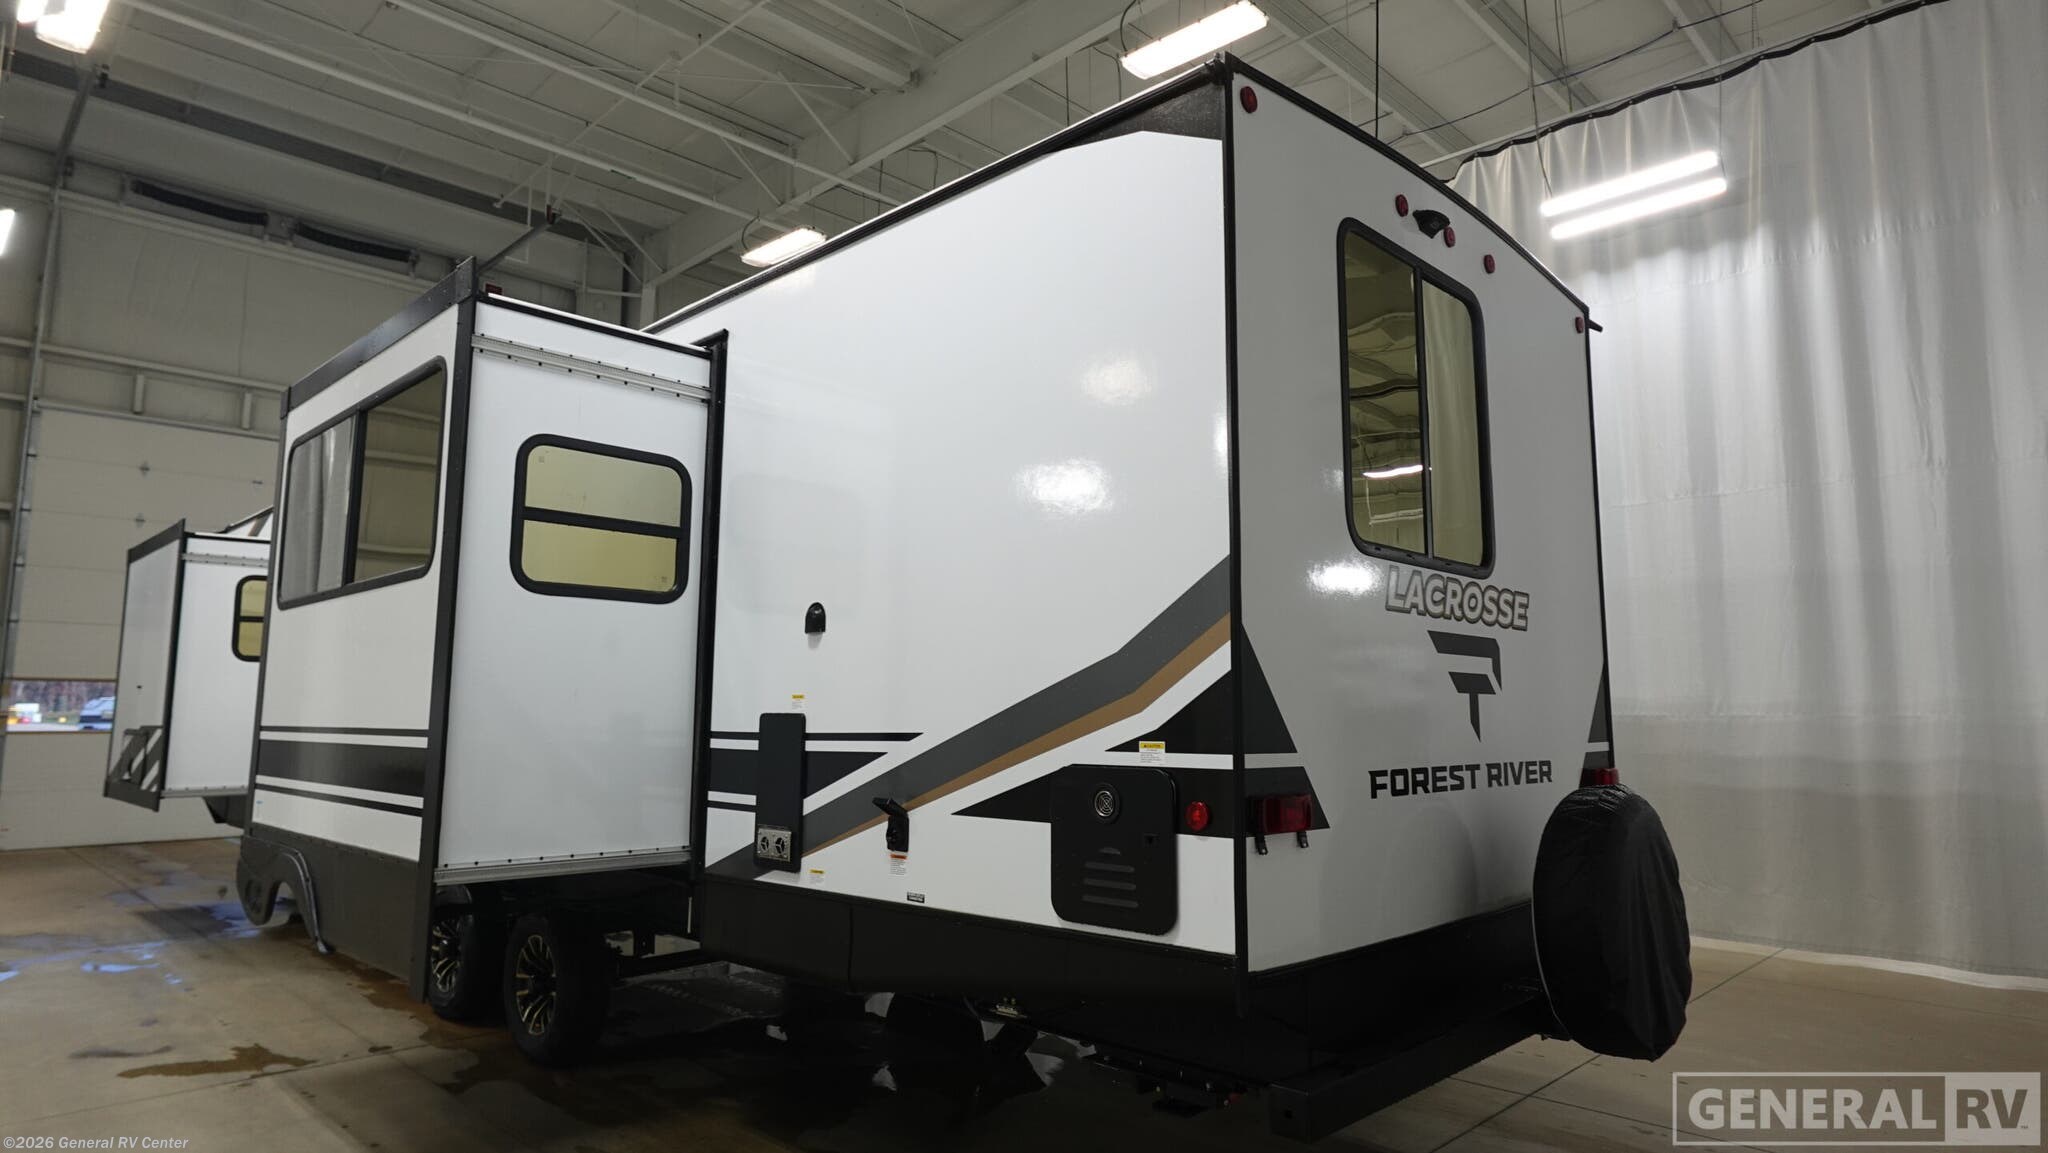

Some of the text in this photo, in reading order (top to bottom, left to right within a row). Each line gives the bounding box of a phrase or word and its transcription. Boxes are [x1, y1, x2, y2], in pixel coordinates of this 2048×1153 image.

[1385, 565, 1530, 631] LACROSSE
[1368, 760, 1553, 799] FOREST RIVER
